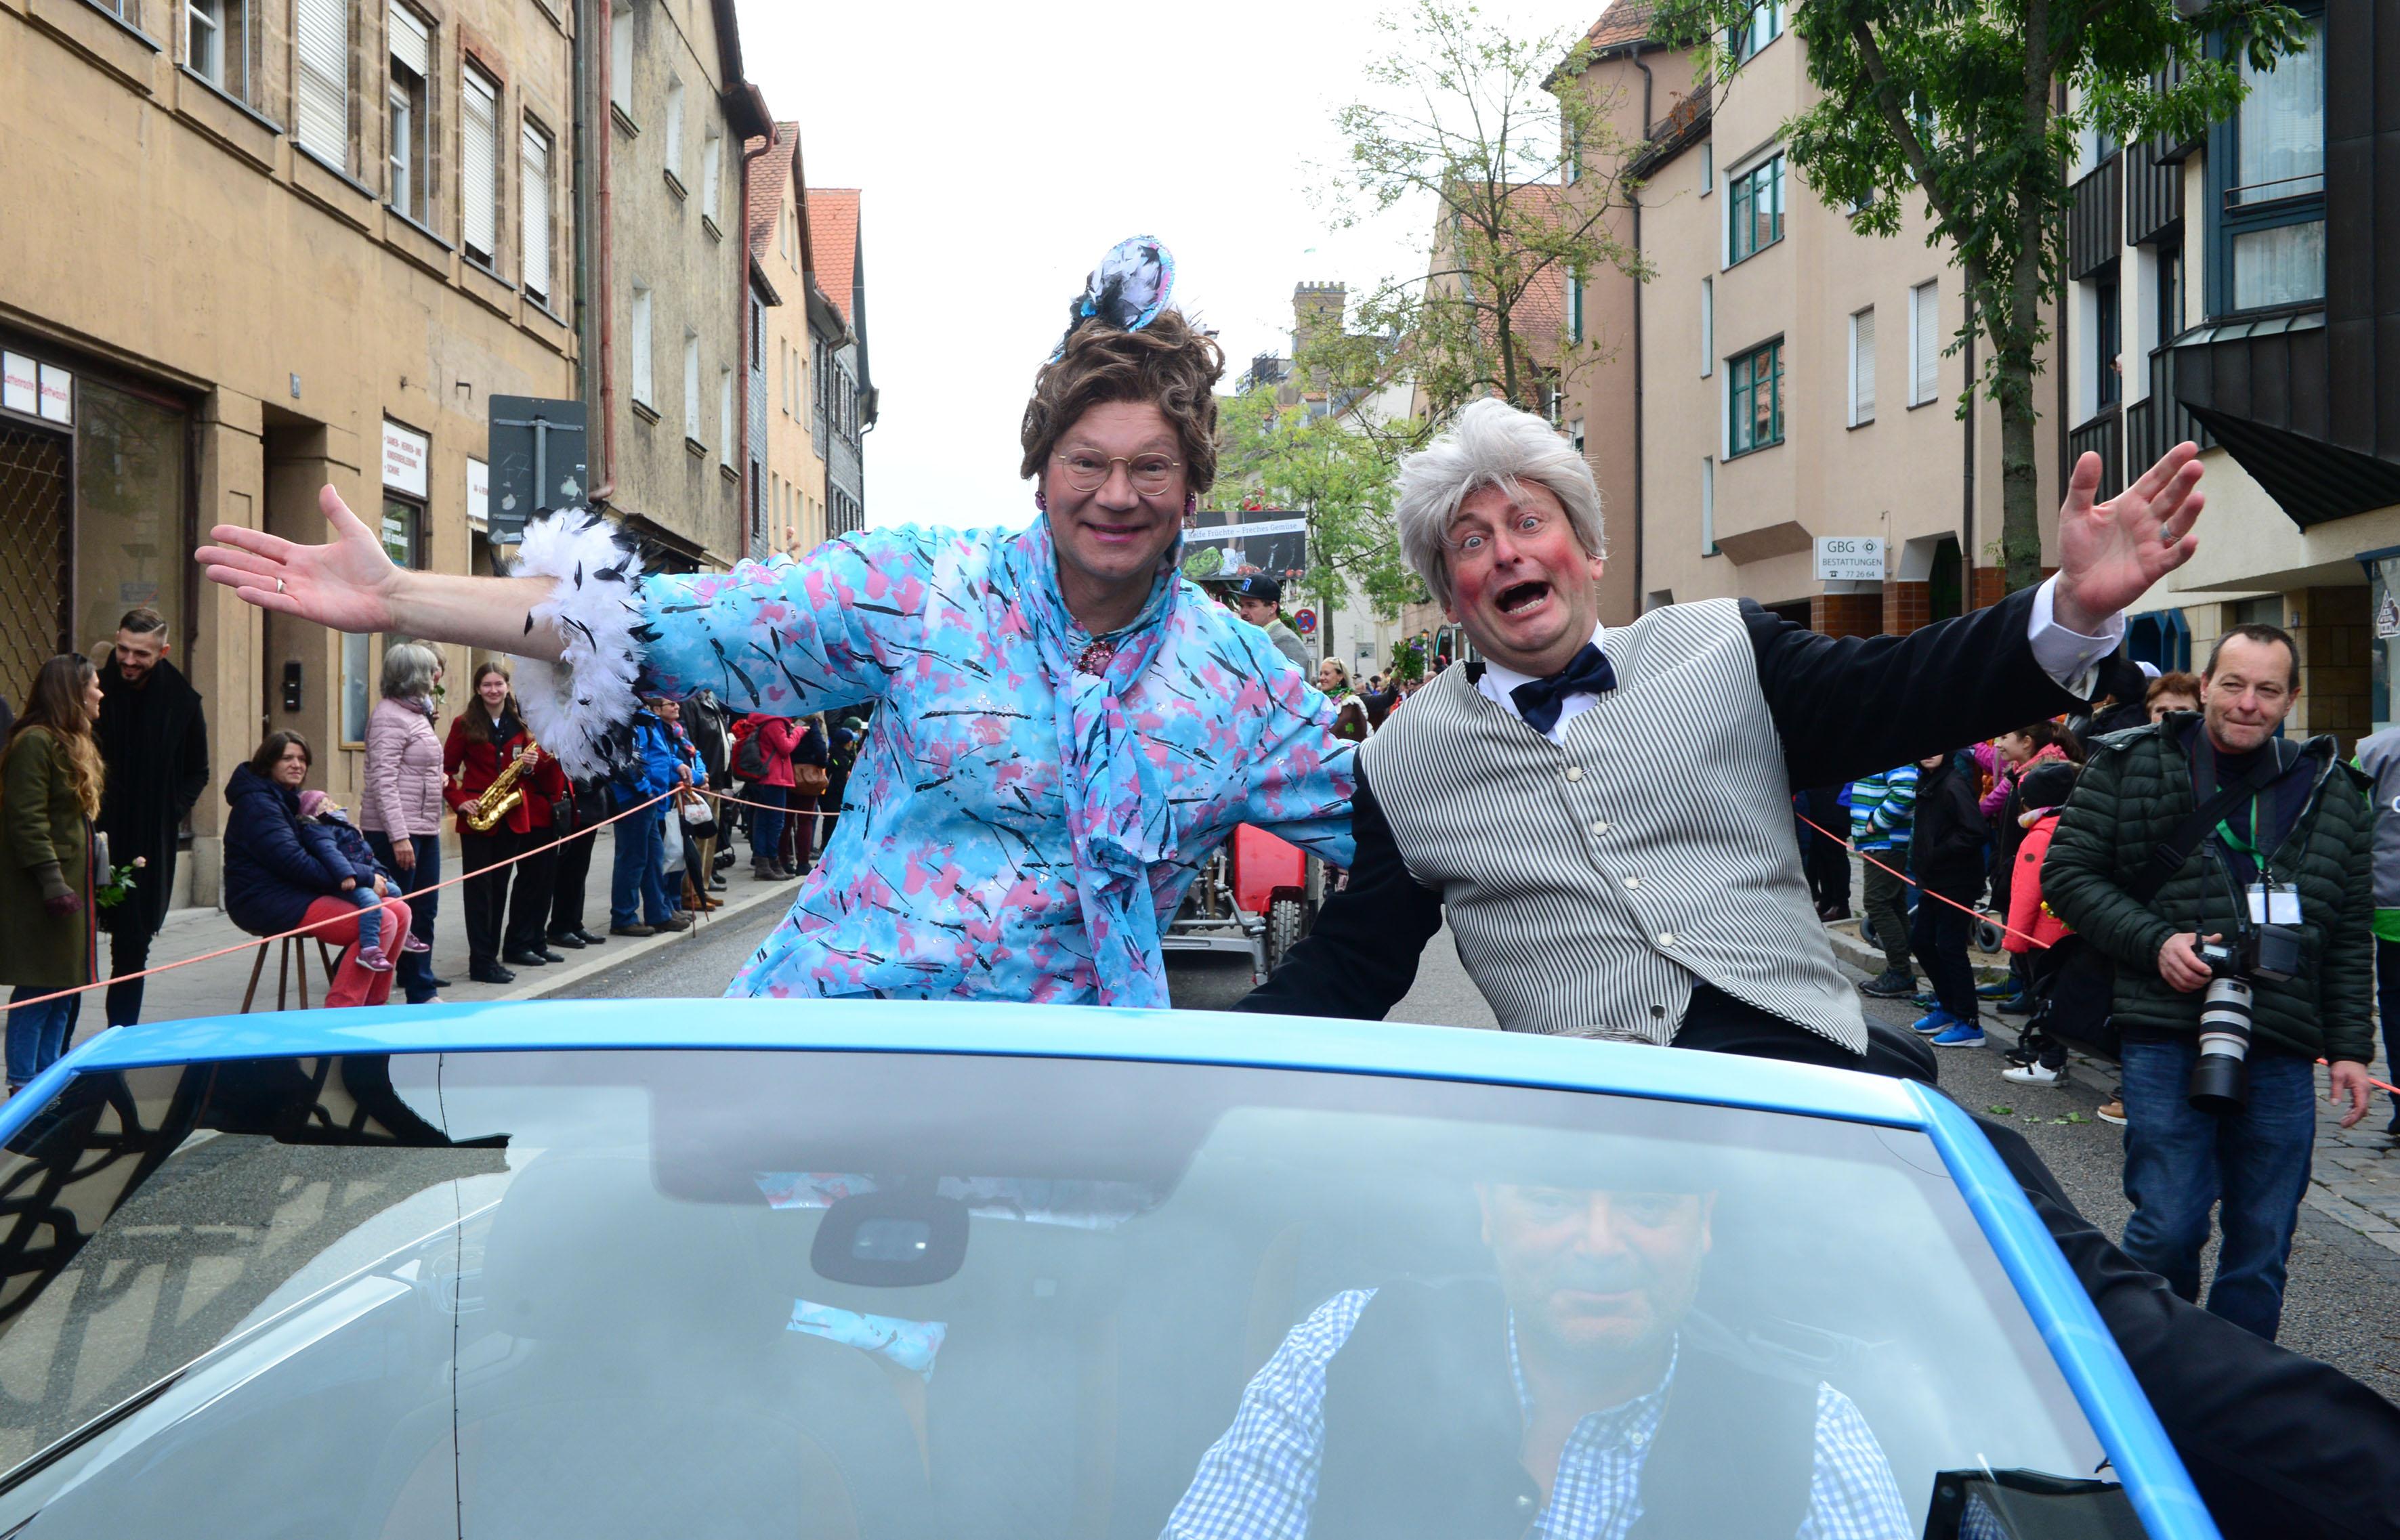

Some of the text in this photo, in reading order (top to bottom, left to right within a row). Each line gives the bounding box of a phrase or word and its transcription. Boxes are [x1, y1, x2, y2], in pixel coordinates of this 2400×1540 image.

[1208, 529, 1234, 537] Früchte
[1242, 526, 1269, 534] Freches
[1270, 523, 1297, 531] Gemüse
[1828, 541, 1855, 553] GBG
